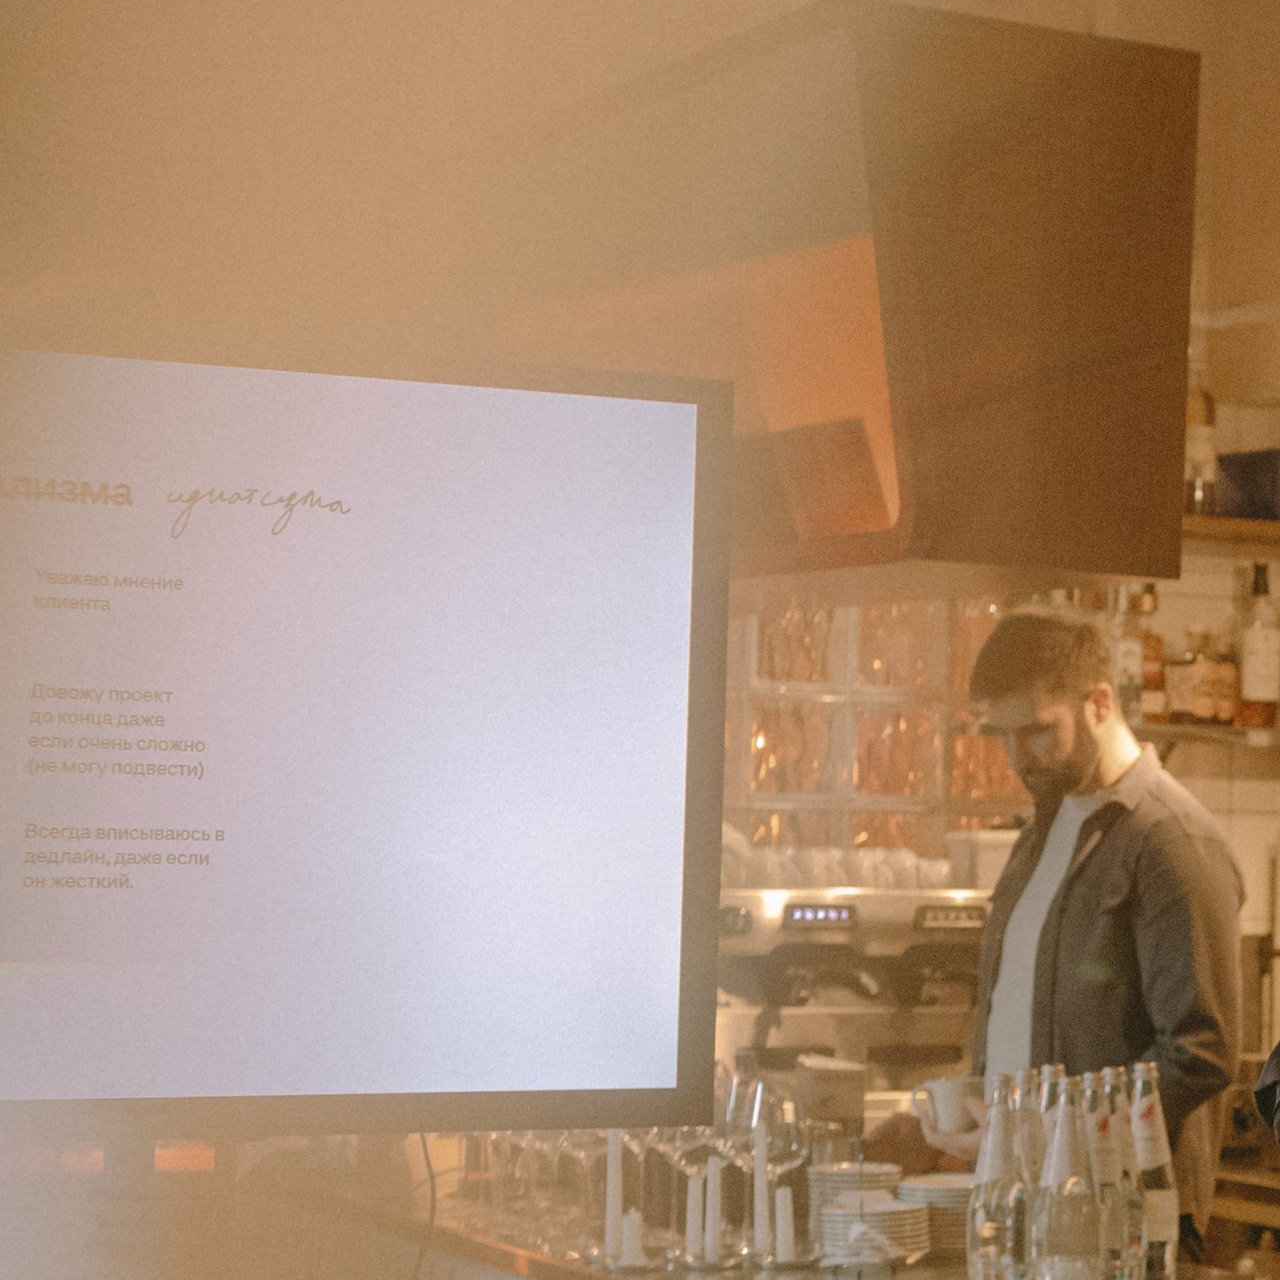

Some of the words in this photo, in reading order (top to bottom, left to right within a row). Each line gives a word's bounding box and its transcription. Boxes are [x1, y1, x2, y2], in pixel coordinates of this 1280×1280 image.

[34, 568, 109, 588] Уважаю
[113, 574, 185, 591] мнение
[33, 594, 112, 612] клиента
[30, 683, 104, 704] Довожу
[108, 688, 174, 706] проект
[28, 710, 53, 725] до
[58, 711, 113, 726] конца
[117, 713, 166, 728] даже
[28, 734, 74, 749] если
[78, 736, 133, 751] очень
[136, 737, 206, 753] сложно
[28, 757, 58, 776] (не
[62, 759, 108, 778] могу
[111, 760, 205, 781] подвести)
[24, 822, 92, 842] Всегда
[96, 827, 211, 842] вписываюсь
[215, 829, 226, 842] в
[23, 848, 111, 867] дедлайн,
[113, 851, 163, 866] даже
[166, 852, 210, 866] если
[23, 875, 45, 889] он
[50, 873, 134, 890] жесткий.
